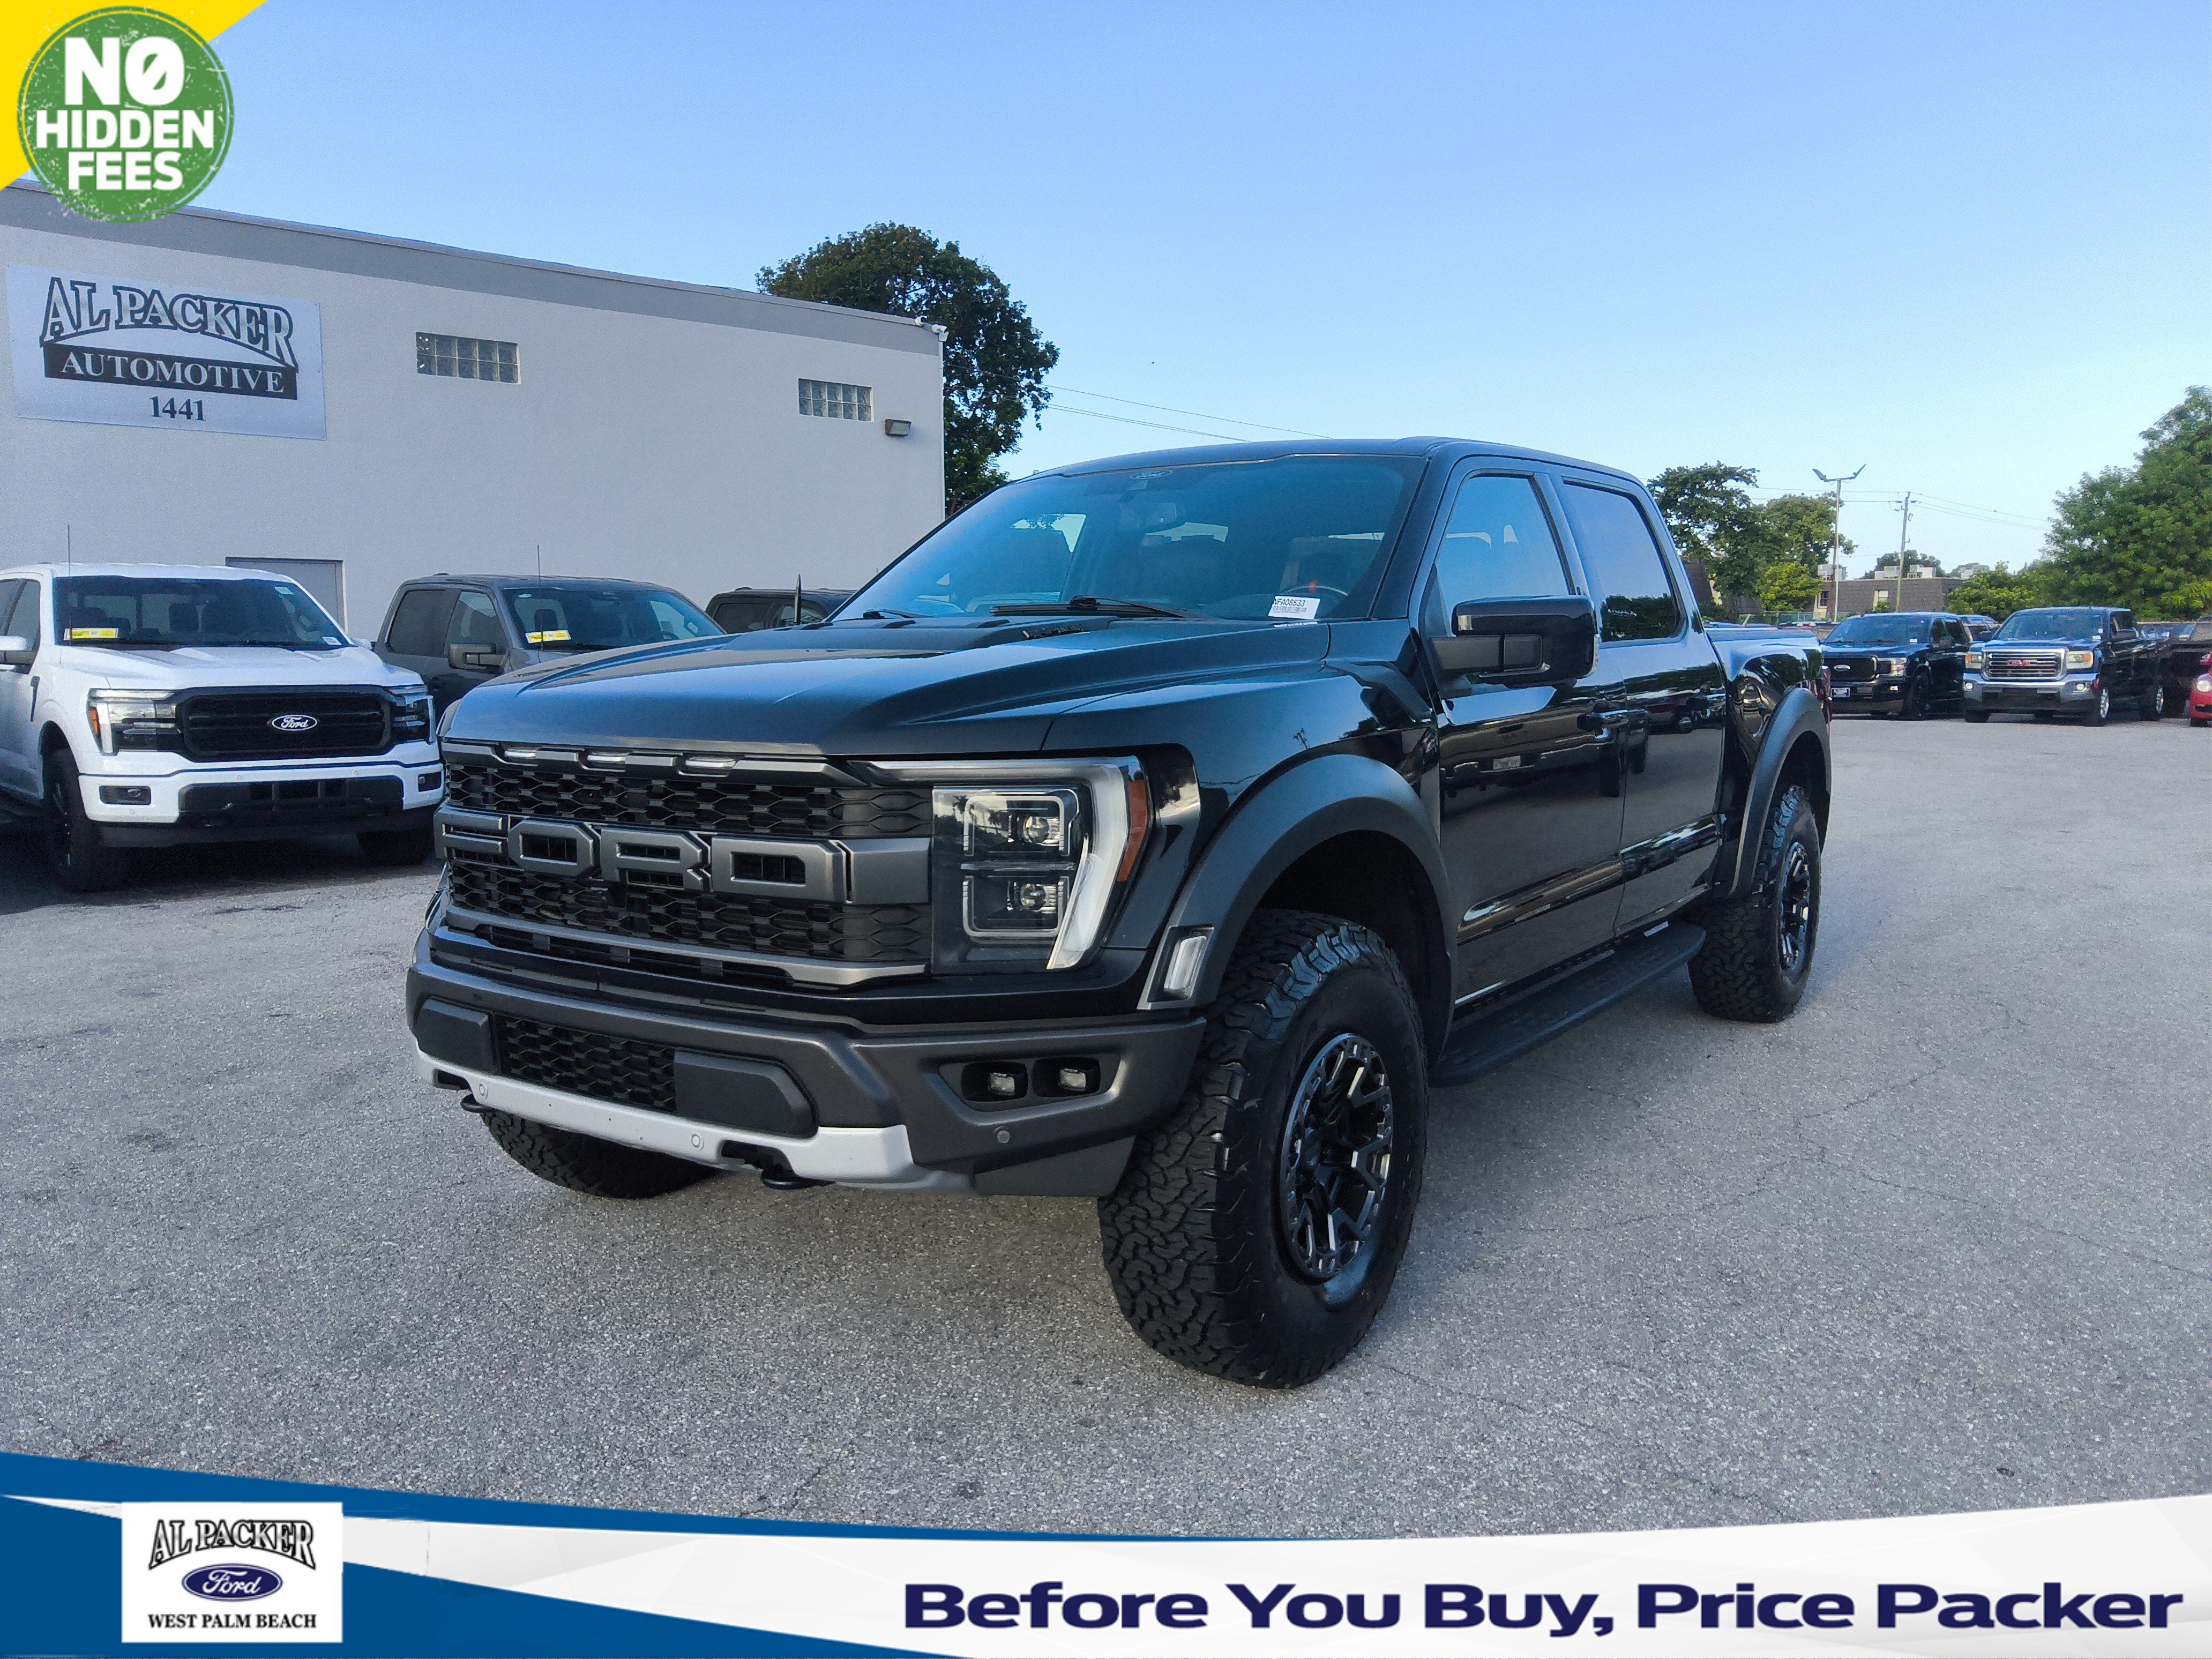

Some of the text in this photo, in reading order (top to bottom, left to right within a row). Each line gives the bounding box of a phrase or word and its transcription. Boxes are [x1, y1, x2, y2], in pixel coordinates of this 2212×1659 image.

[40, 276, 298, 373] AL PACKER
[60, 351, 285, 393] AUTOMOTIVE
[149, 395, 206, 421] 1441
[281, 716, 309, 728] Ford
[434, 804, 852, 906] FORD
